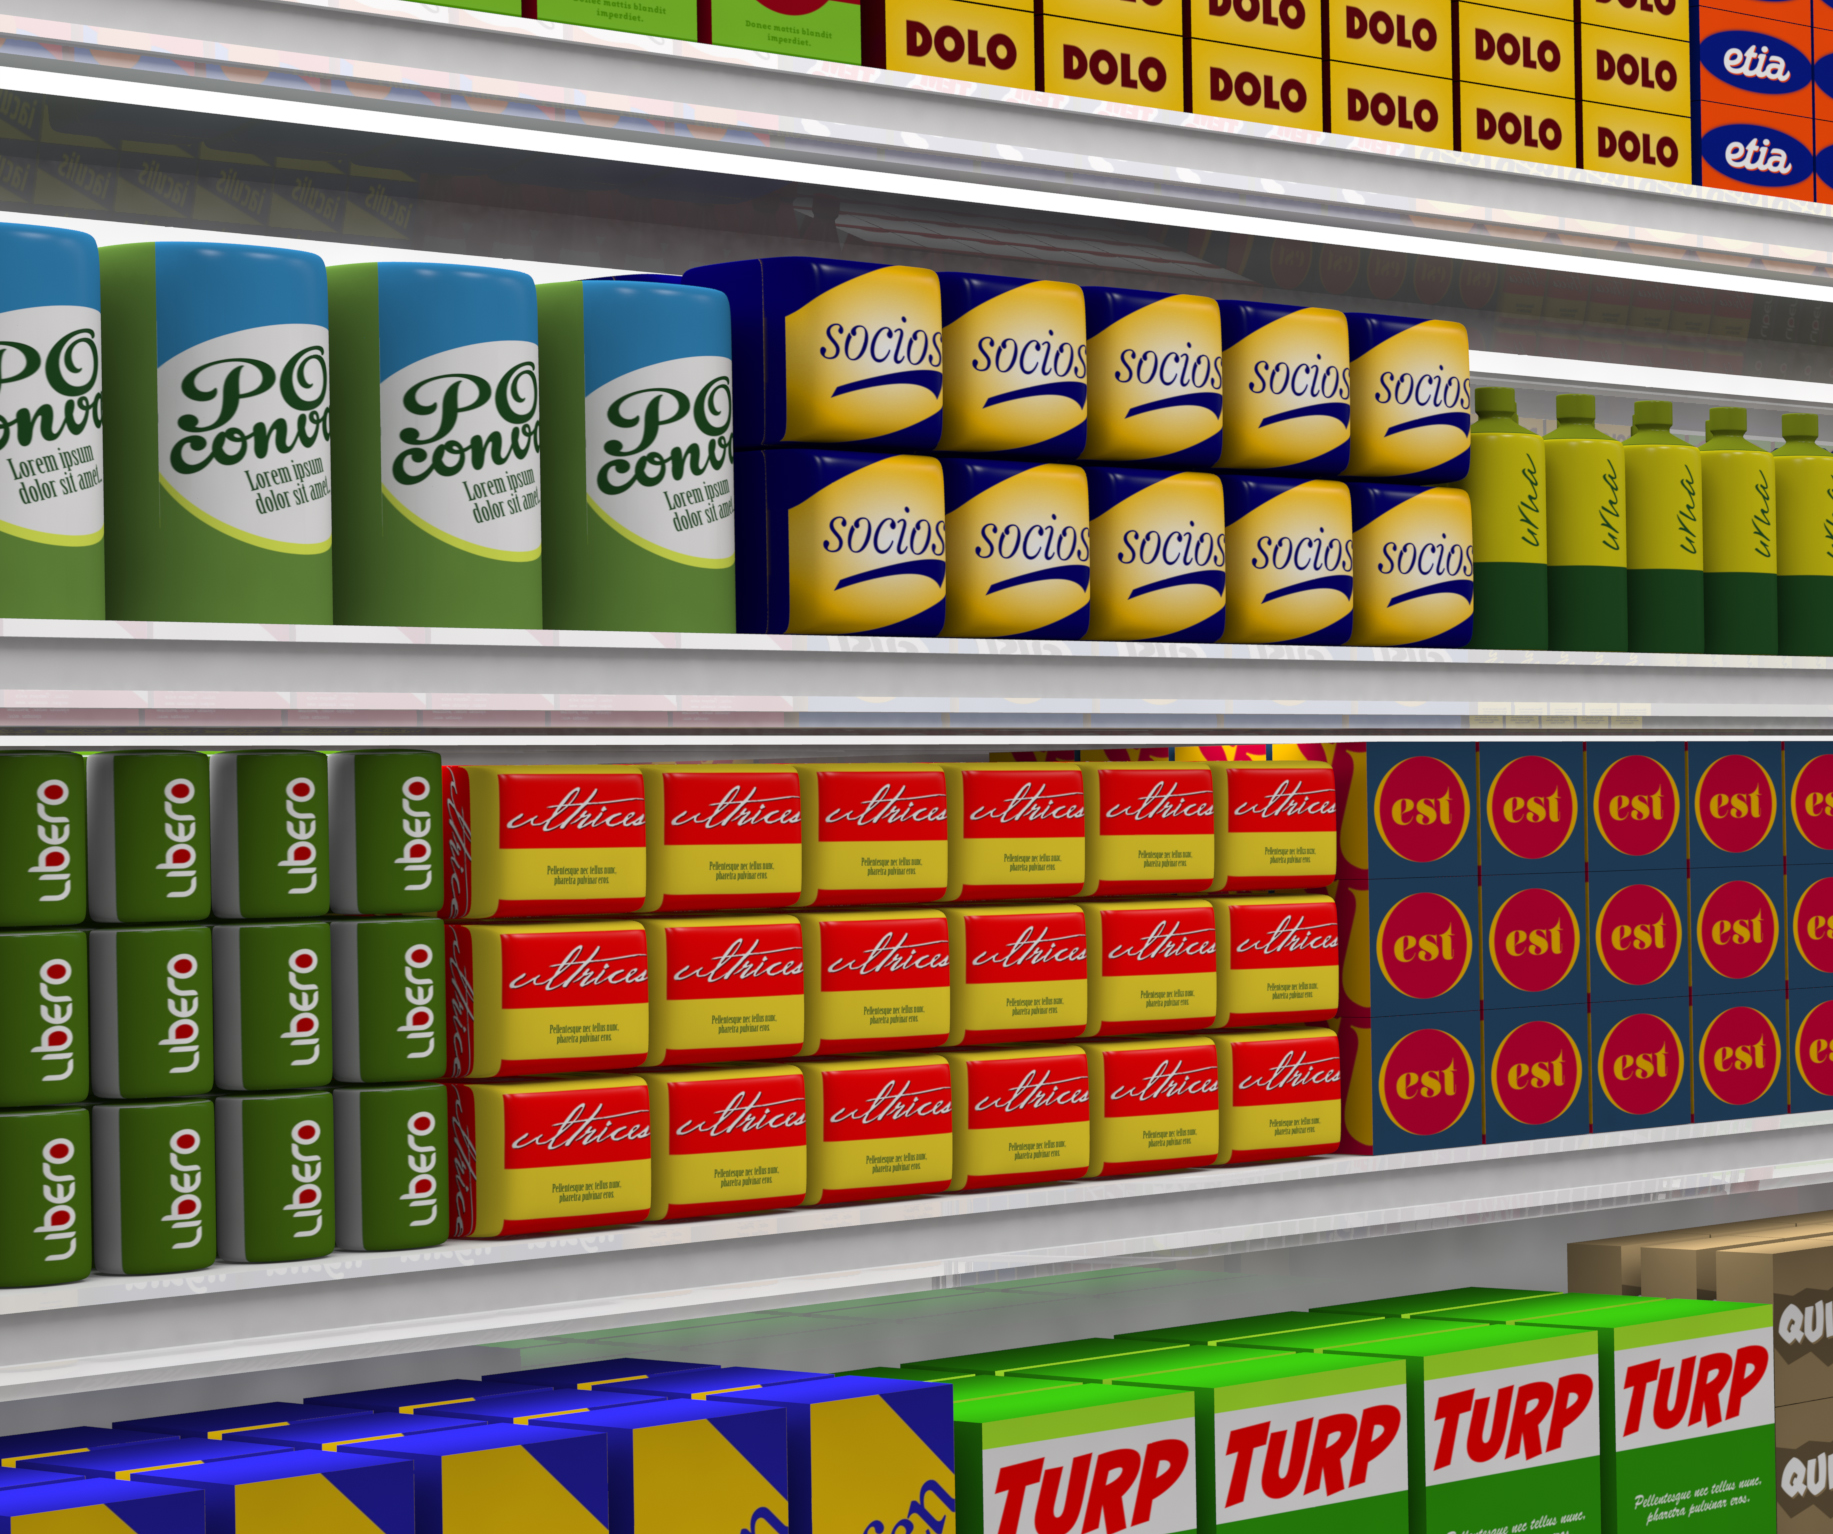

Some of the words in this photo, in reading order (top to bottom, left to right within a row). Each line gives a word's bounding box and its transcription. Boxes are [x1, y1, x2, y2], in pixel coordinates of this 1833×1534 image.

[819, 315, 942, 368] socios
[972, 329, 1088, 379] socios
[1114, 342, 1223, 389] socios
[178, 345, 327, 432] PO
[401, 360, 539, 446] PO
[244, 465, 291, 491] Lorem
[291, 457, 324, 484] ipsum
[256, 489, 291, 514] dolor
[294, 483, 309, 505] sit
[1520, 452, 1539, 549] urna
[1601, 458, 1621, 552] urna
[1391, 787, 1453, 826] est
[1503, 786, 1562, 824] est
[1608, 784, 1664, 822] est
[1709, 783, 1762, 819] est
[1433, 1372, 1594, 1472] TURP
[1224, 1403, 1402, 1508] TURP
